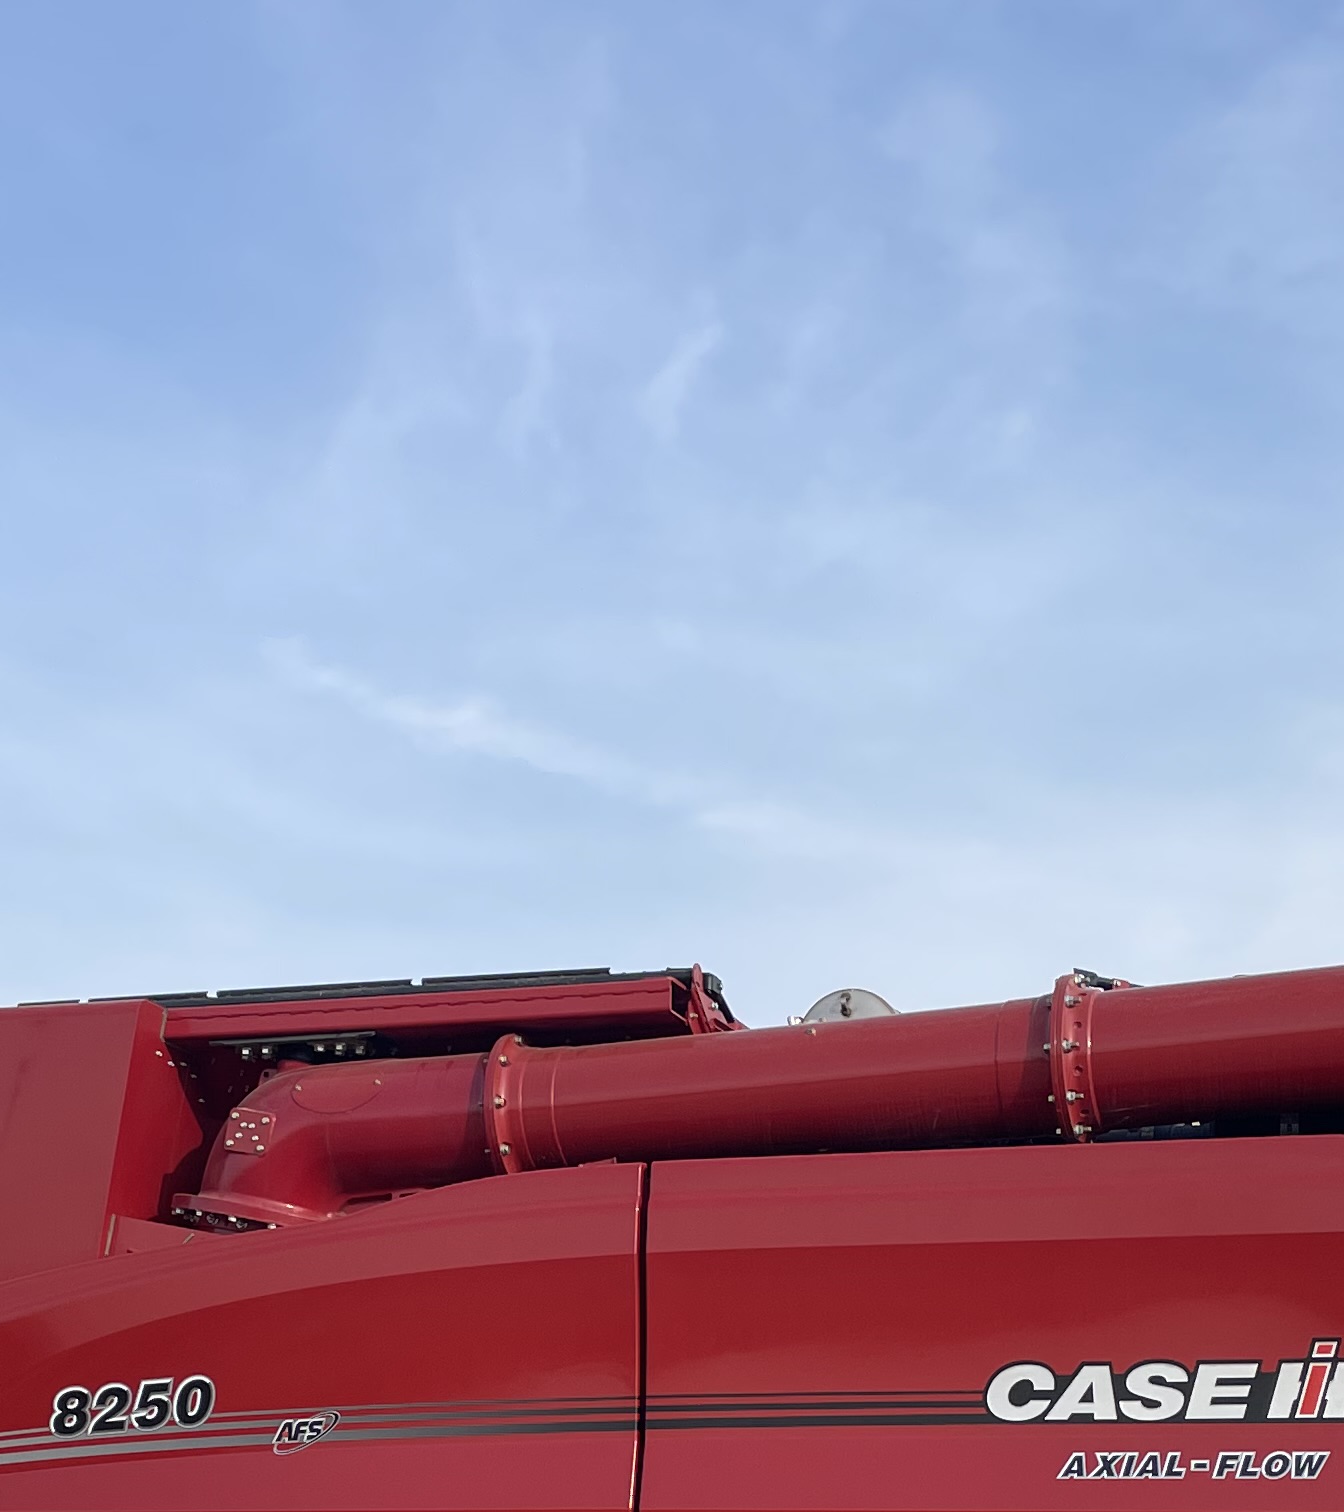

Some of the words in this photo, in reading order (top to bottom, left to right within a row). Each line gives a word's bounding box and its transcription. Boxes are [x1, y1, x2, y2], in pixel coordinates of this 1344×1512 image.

[49, 1374, 216, 1438] 8250
[985, 1361, 1261, 1423] CASE
[272, 1418, 326, 1444] AFS
[1056, 1451, 1331, 1480] AXIAL-FLOW
